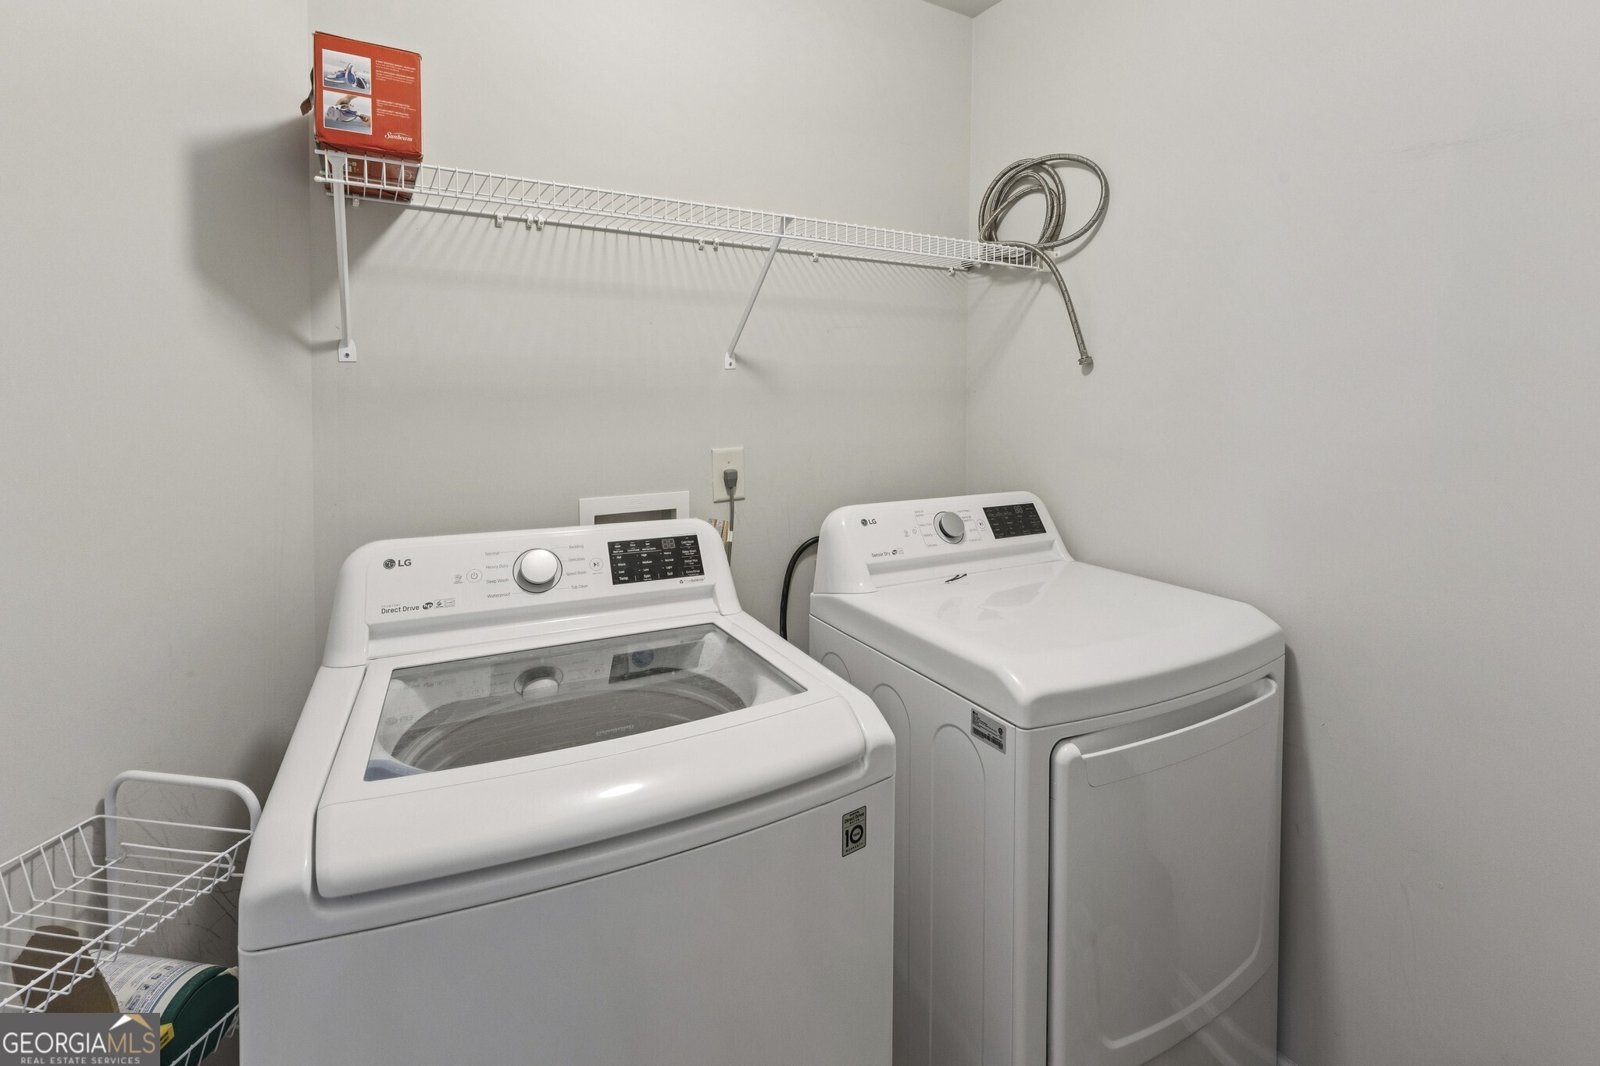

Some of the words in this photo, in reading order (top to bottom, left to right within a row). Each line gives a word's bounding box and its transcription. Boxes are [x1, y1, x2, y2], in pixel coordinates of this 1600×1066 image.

[385, 131, 413, 142] Sunbeam
[397, 558, 412, 567] LG
[381, 606, 401, 615] Direct
[402, 604, 420, 613] Drive
[845, 824, 864, 848] 10
